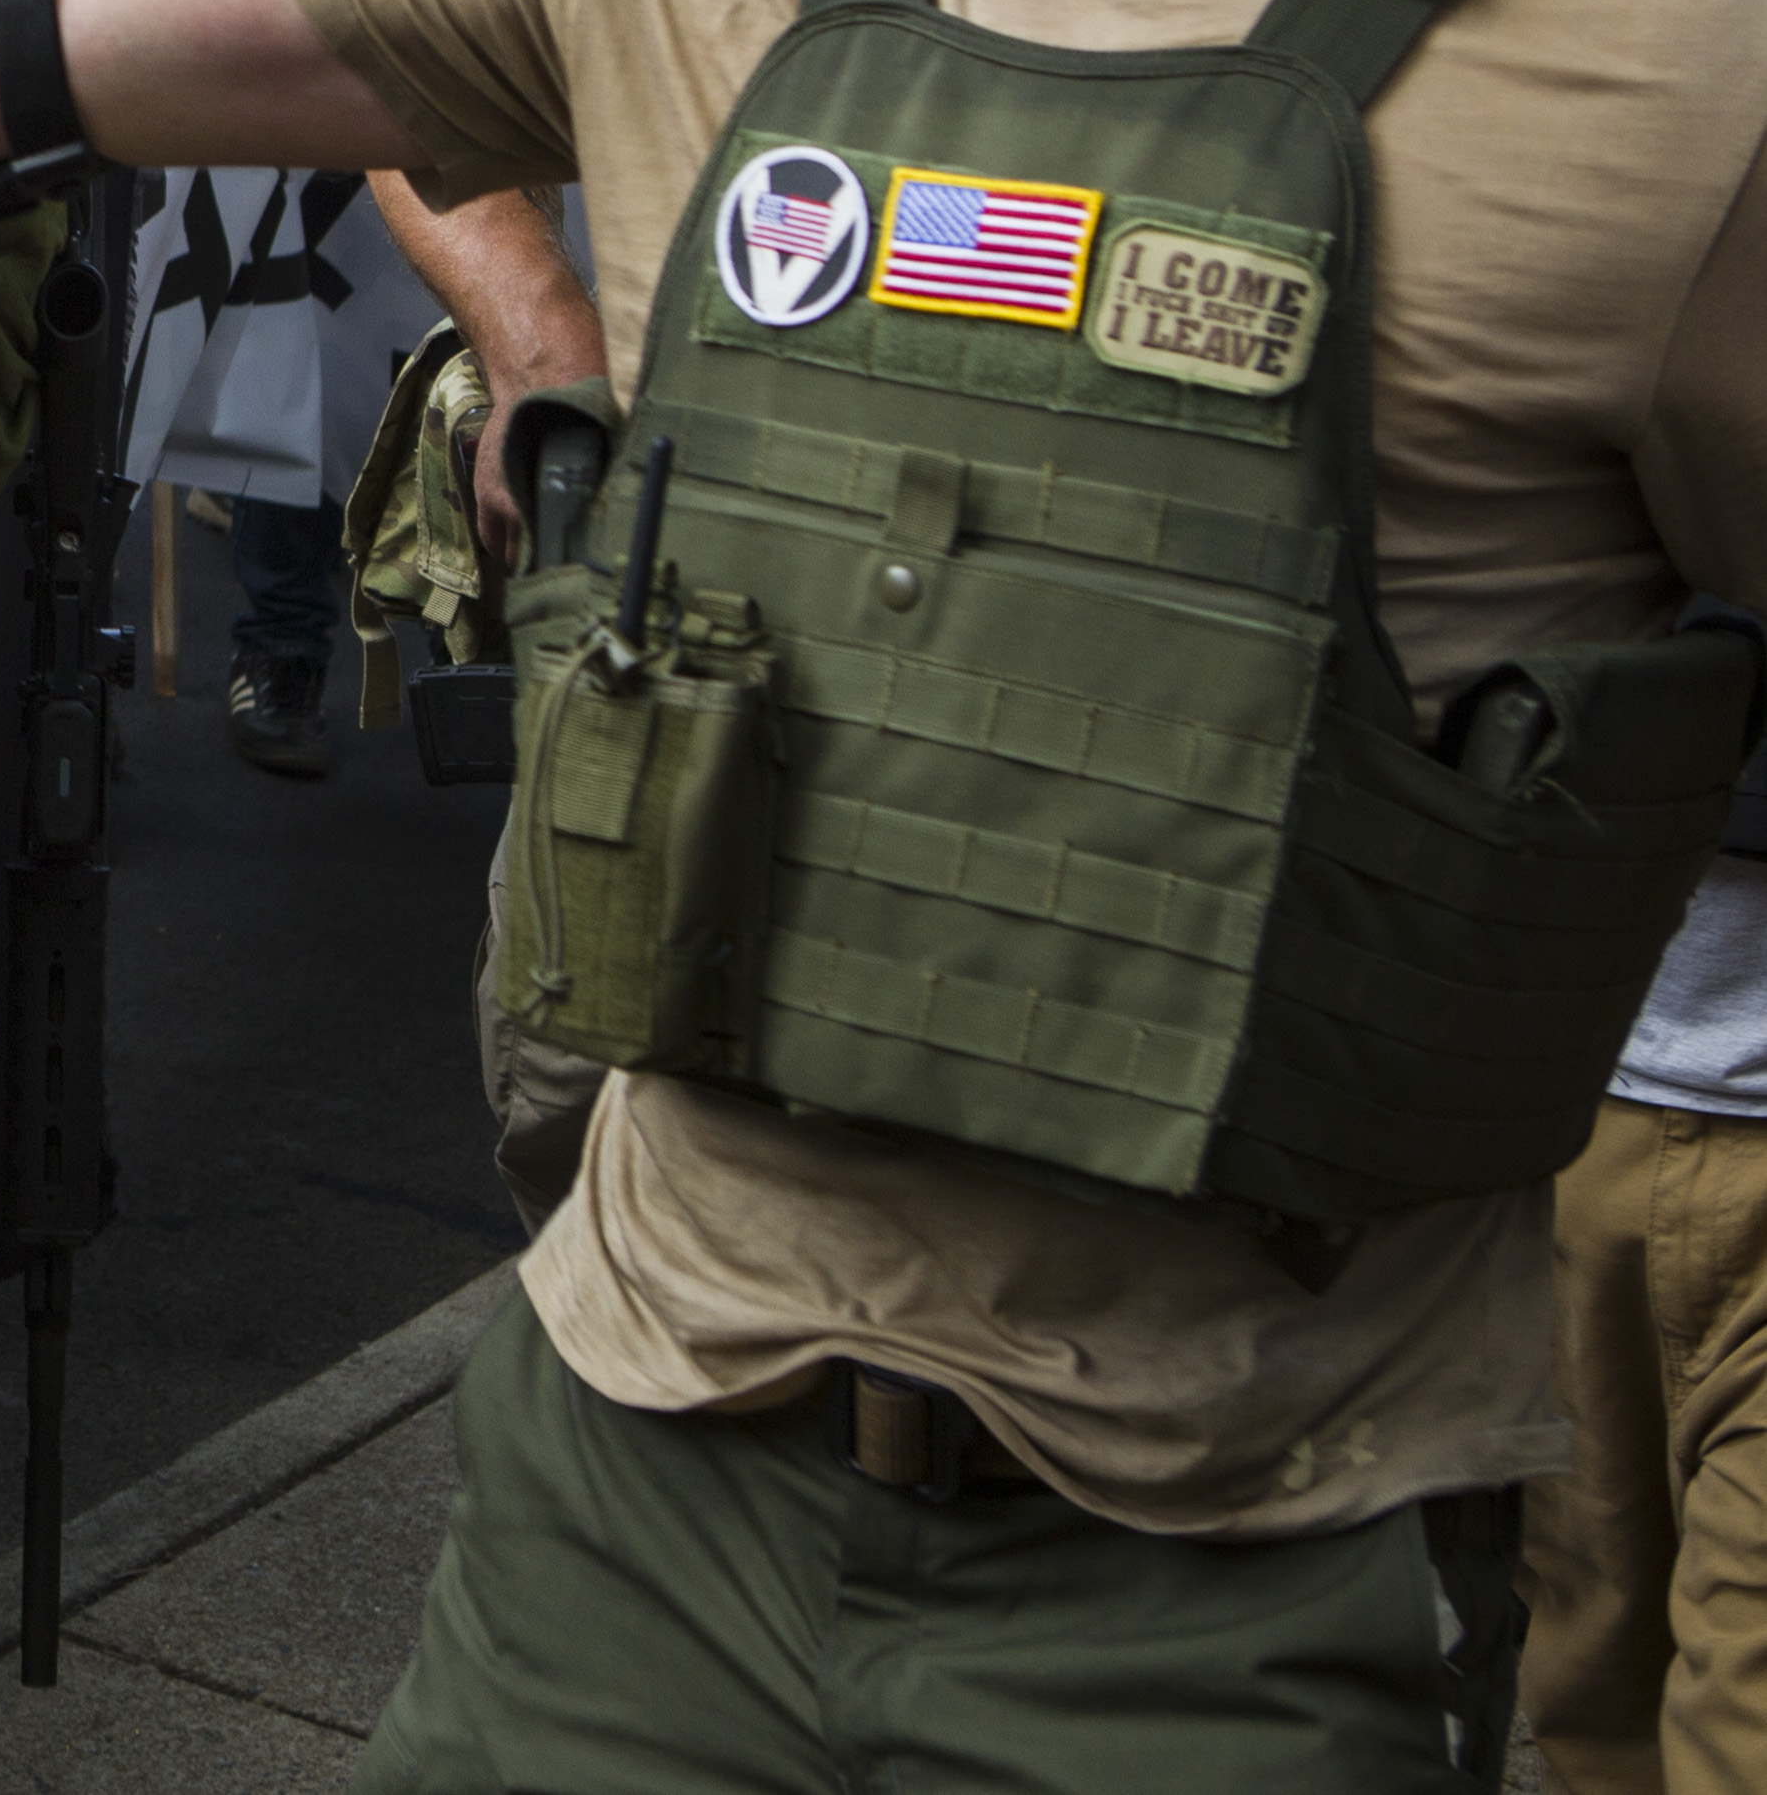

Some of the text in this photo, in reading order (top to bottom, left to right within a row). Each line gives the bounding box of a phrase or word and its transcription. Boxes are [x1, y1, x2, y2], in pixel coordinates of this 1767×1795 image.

[1121, 242, 1309, 319] I COME
[1139, 311, 1292, 378] LEAVE
